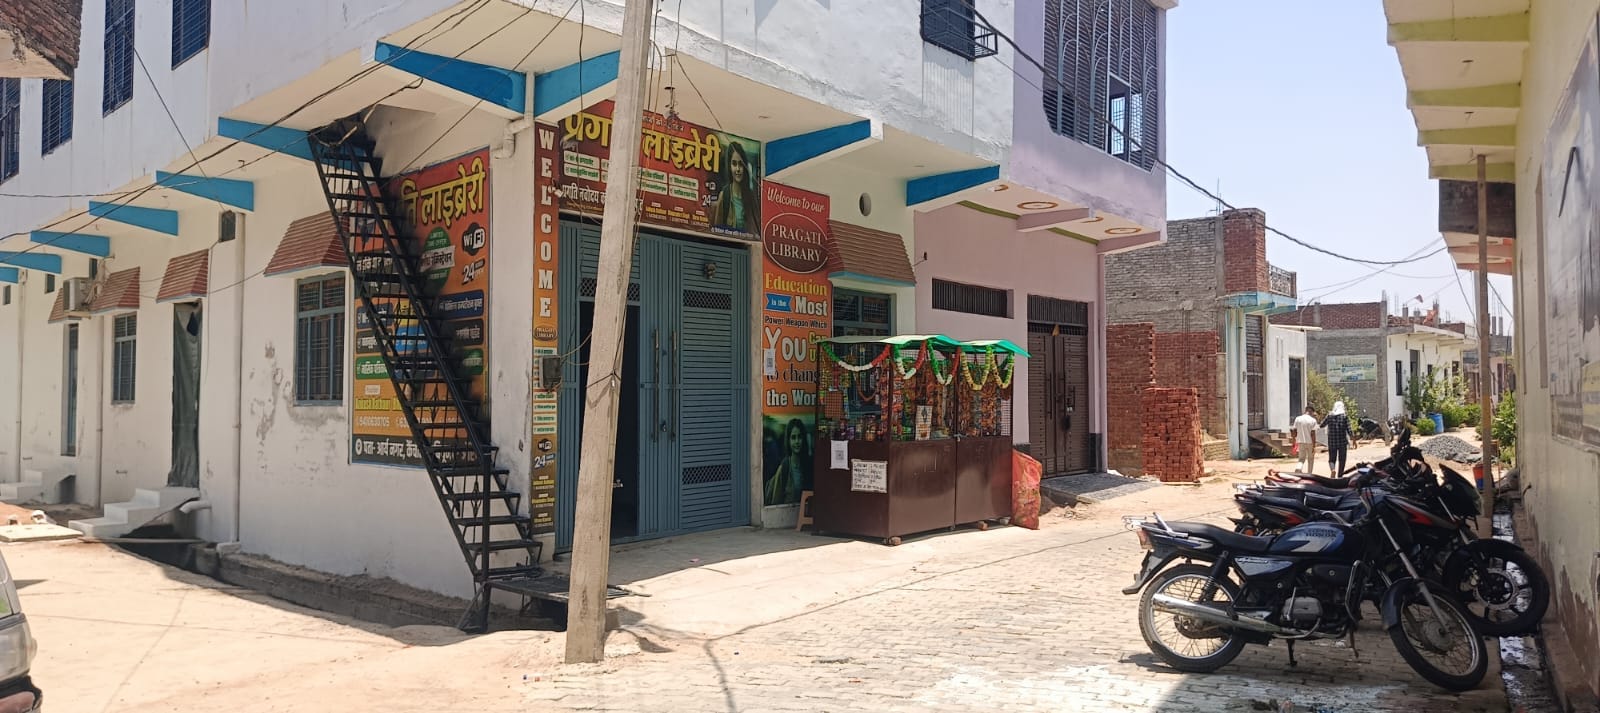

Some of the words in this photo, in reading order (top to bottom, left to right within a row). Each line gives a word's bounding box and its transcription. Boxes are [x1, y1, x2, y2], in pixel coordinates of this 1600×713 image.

[564, 111, 613, 148] प्रग
[421, 156, 486, 228] लाइब्रेरी
[768, 187, 800, 207] Welcome
[802, 197, 810, 210] to
[811, 202, 825, 213] our
[539, 128, 555, 318] WELCOME
[772, 223, 821, 245] PRAGATI
[772, 242, 821, 262] LIBRARY
[463, 262, 474, 284] 24
[765, 272, 827, 296] Education
[795, 295, 827, 316] Most
[767, 388, 788, 407] the
[792, 389, 817, 407] Wor
